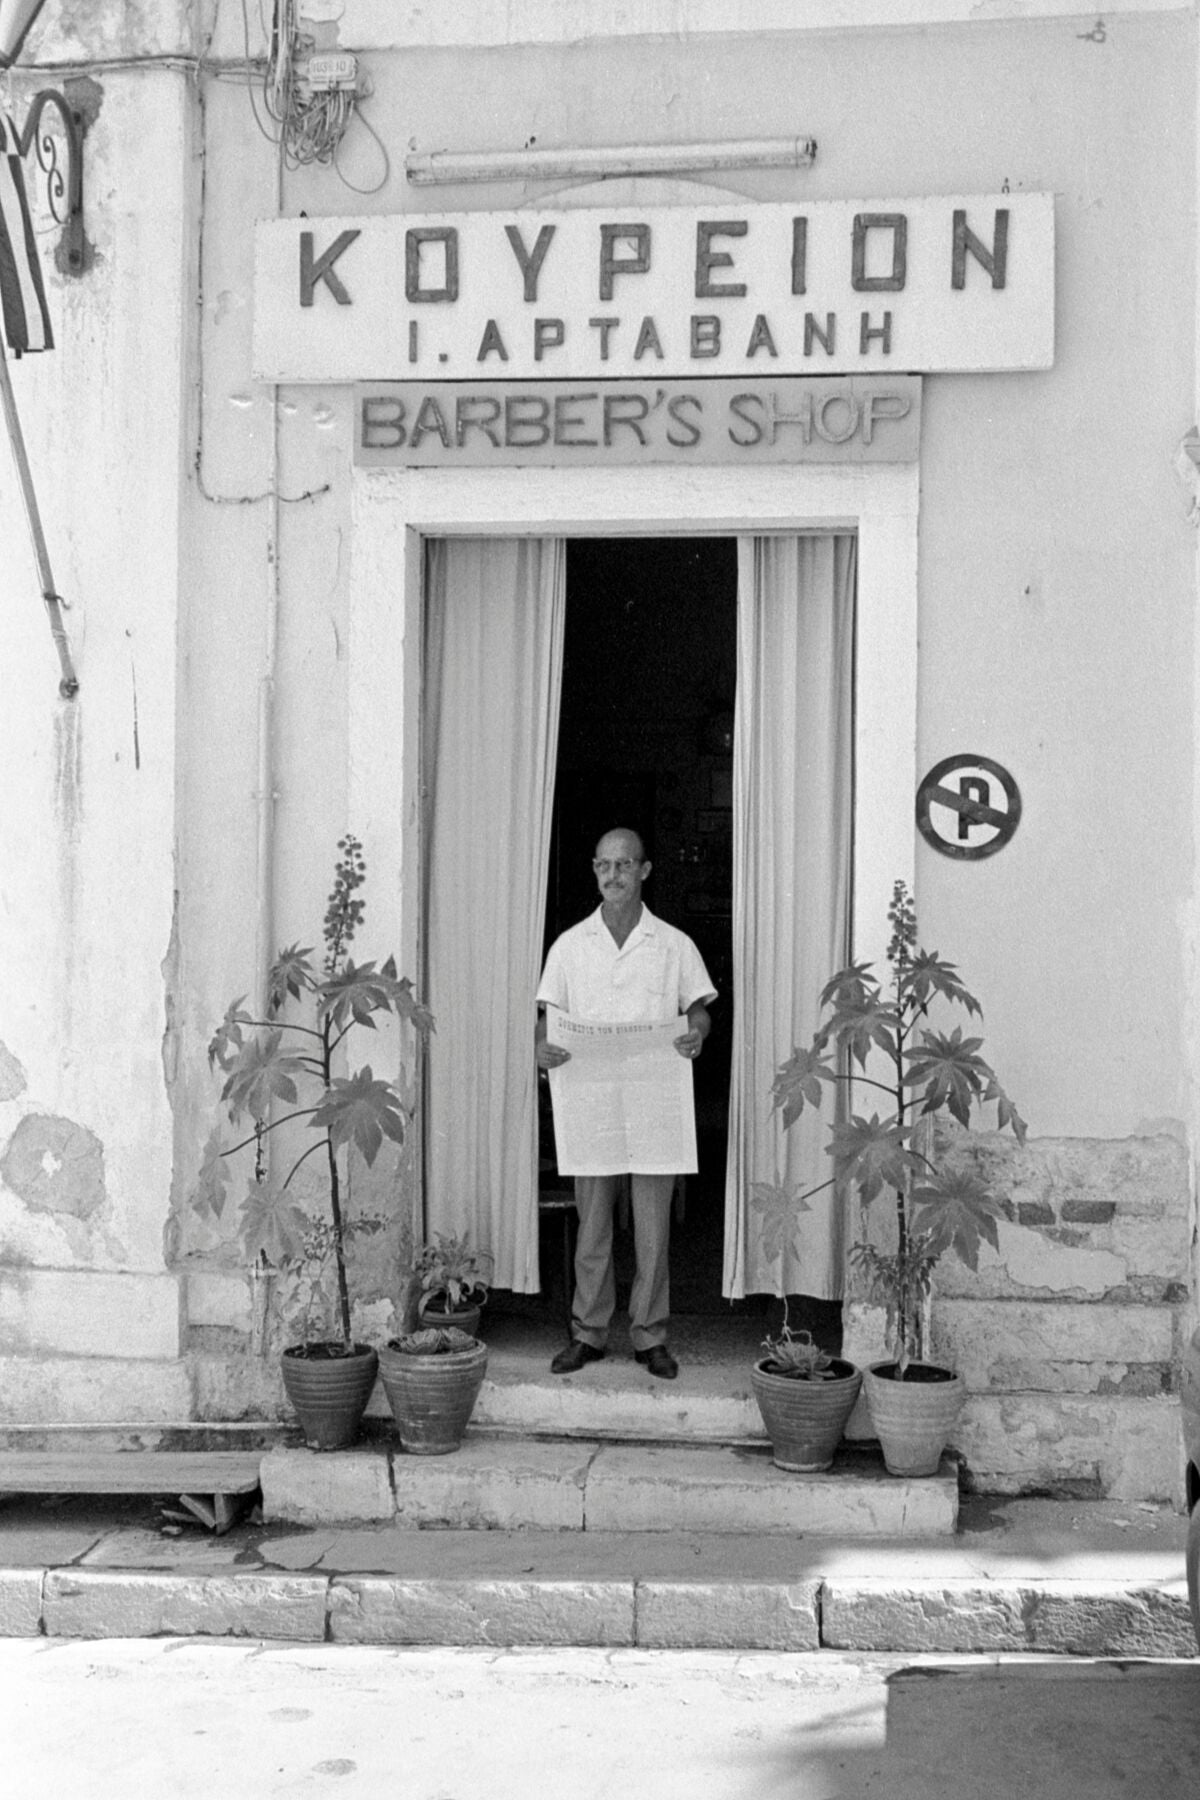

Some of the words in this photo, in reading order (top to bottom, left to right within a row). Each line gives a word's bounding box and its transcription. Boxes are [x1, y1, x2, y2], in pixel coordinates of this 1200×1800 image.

[298, 208, 1010, 306] ΚΟΥΡΕΙΟΝ
[476, 311, 892, 363] ΑΡΤΑΒΑΝΗ
[360, 389, 703, 448] BARBER'S
[728, 391, 911, 447] SHOP
